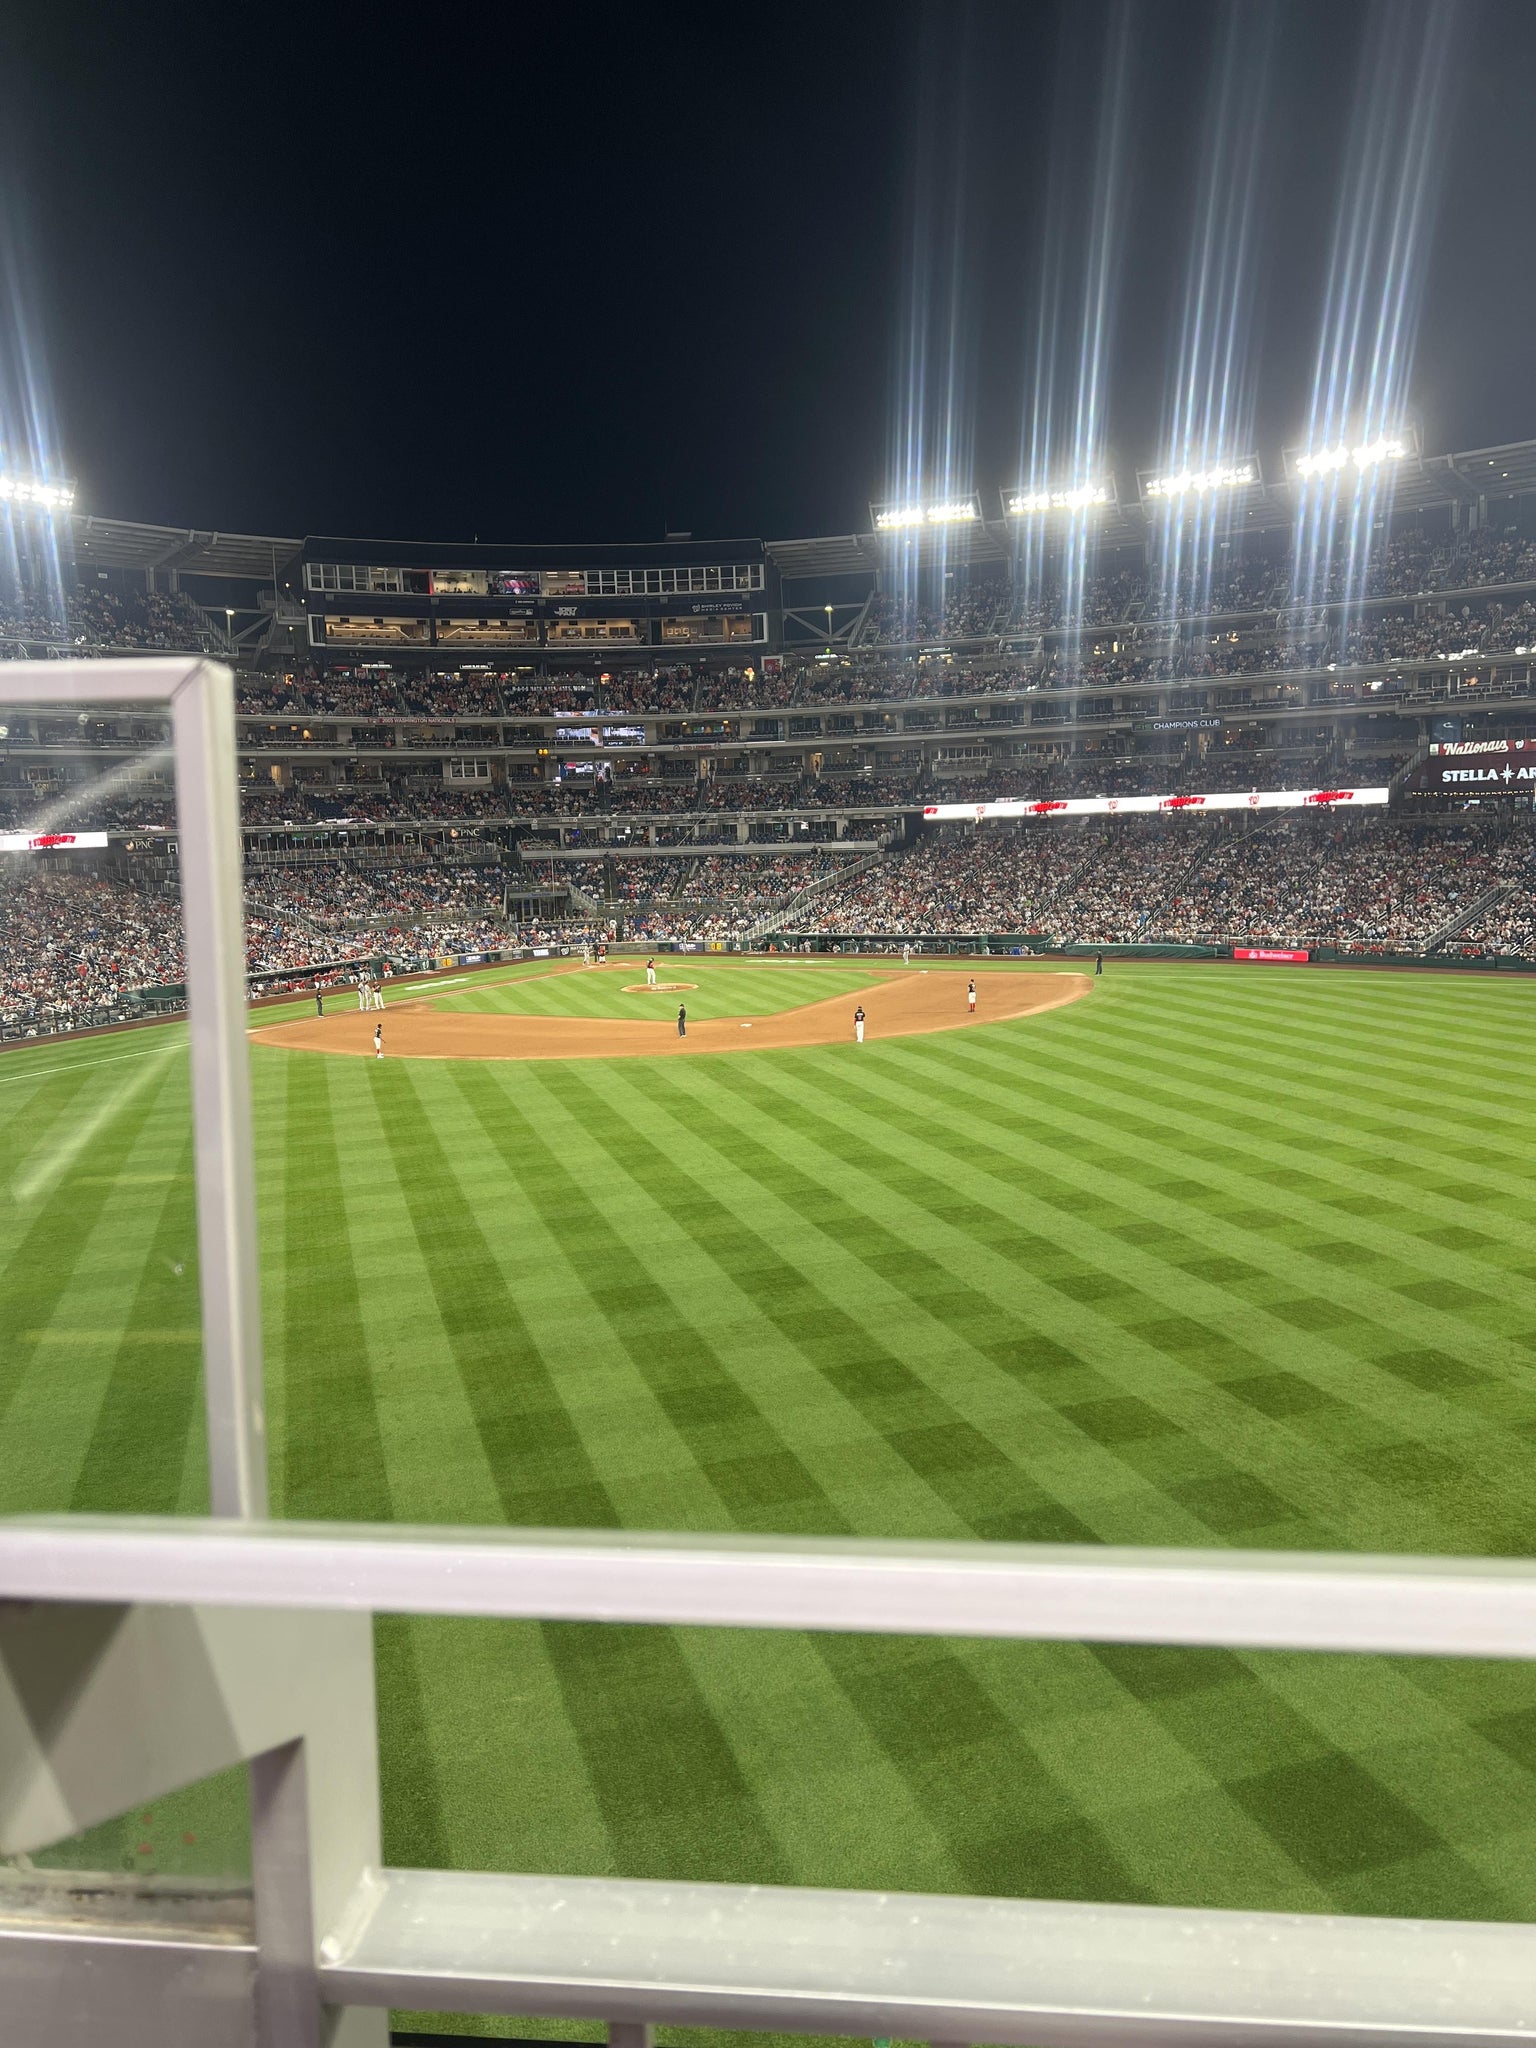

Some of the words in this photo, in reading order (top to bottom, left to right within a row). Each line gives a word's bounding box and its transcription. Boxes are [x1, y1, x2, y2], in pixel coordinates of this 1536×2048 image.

[1153, 720, 1199, 730] CHAMPIONS
[1199, 719, 1221, 727] CLUB
[1443, 740, 1509, 756] Nationals
[1442, 768, 1499, 783] STELLA
[460, 828, 480, 837] PNC
[135, 840, 154, 850] PNC
